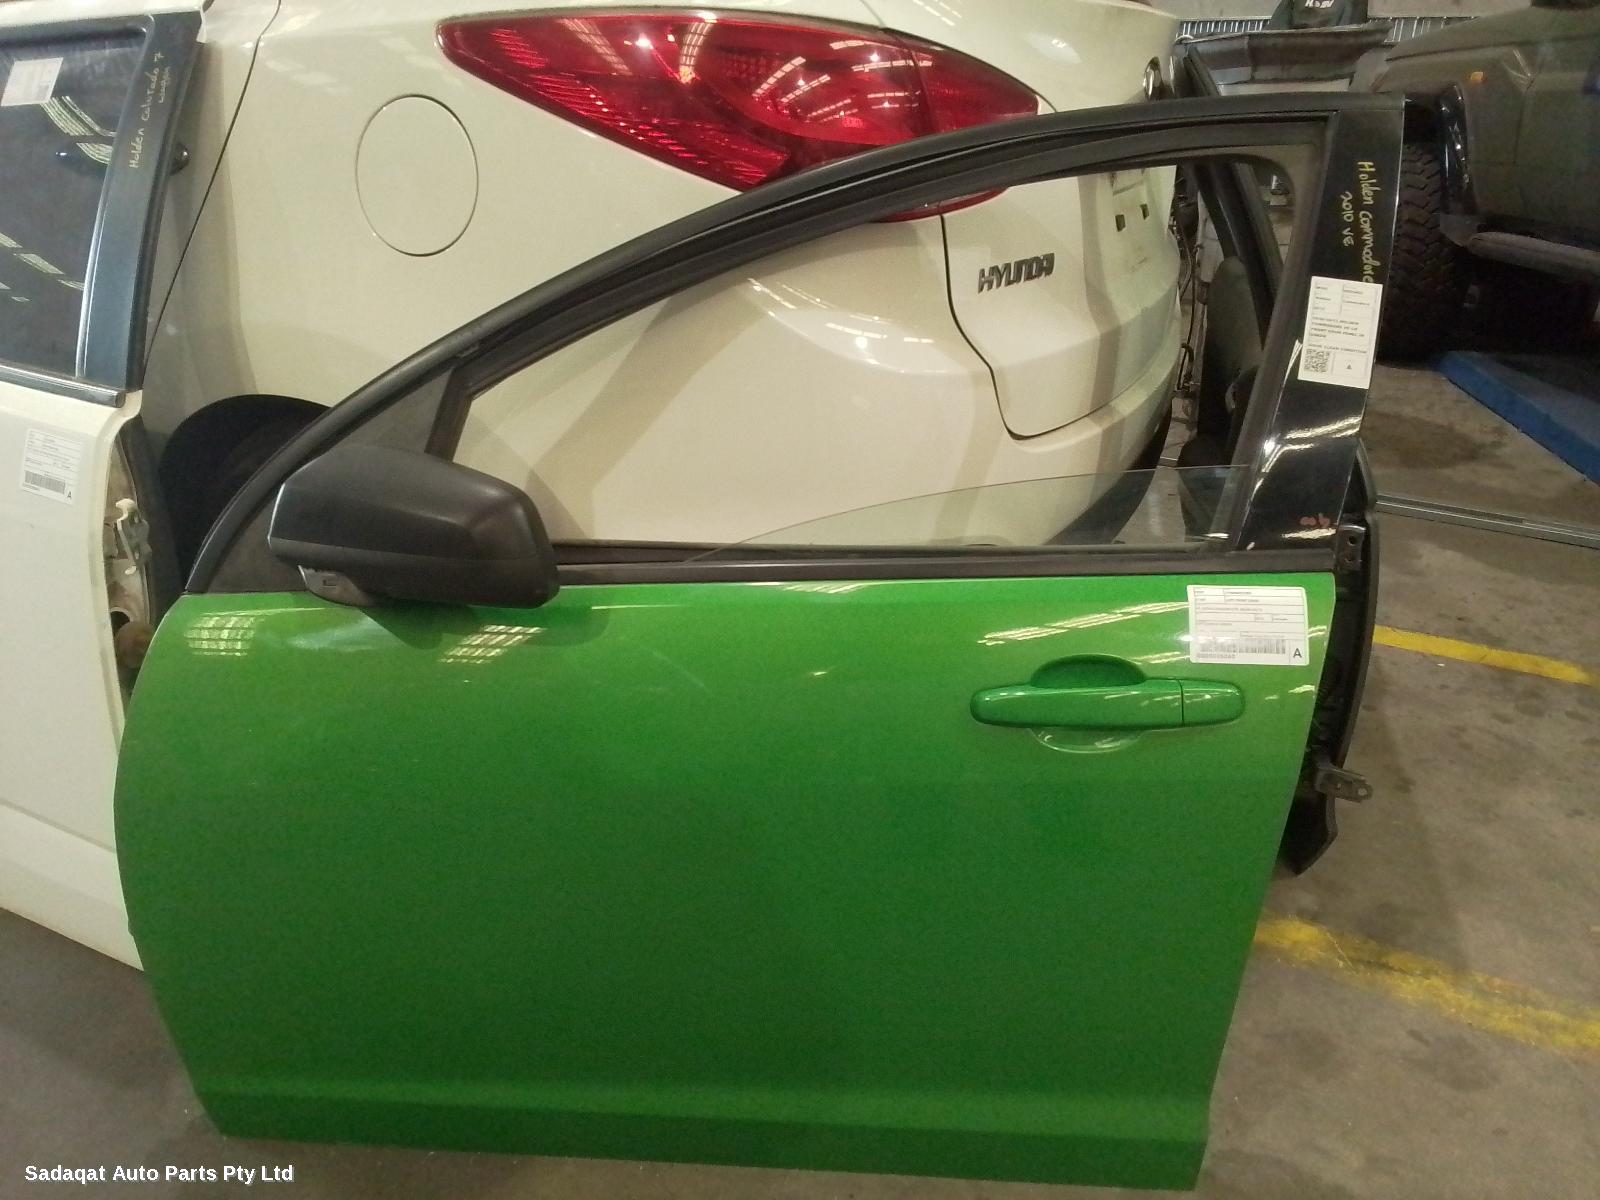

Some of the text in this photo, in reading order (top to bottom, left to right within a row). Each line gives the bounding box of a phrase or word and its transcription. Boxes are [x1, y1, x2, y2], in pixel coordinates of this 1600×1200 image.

[129, 128, 145, 168] Holden
[1358, 161, 1381, 205] Holden
[1340, 191, 1354, 222] 2010
[978, 252, 1055, 294] HYUNDAI
[1293, 648, 1302, 658] A
